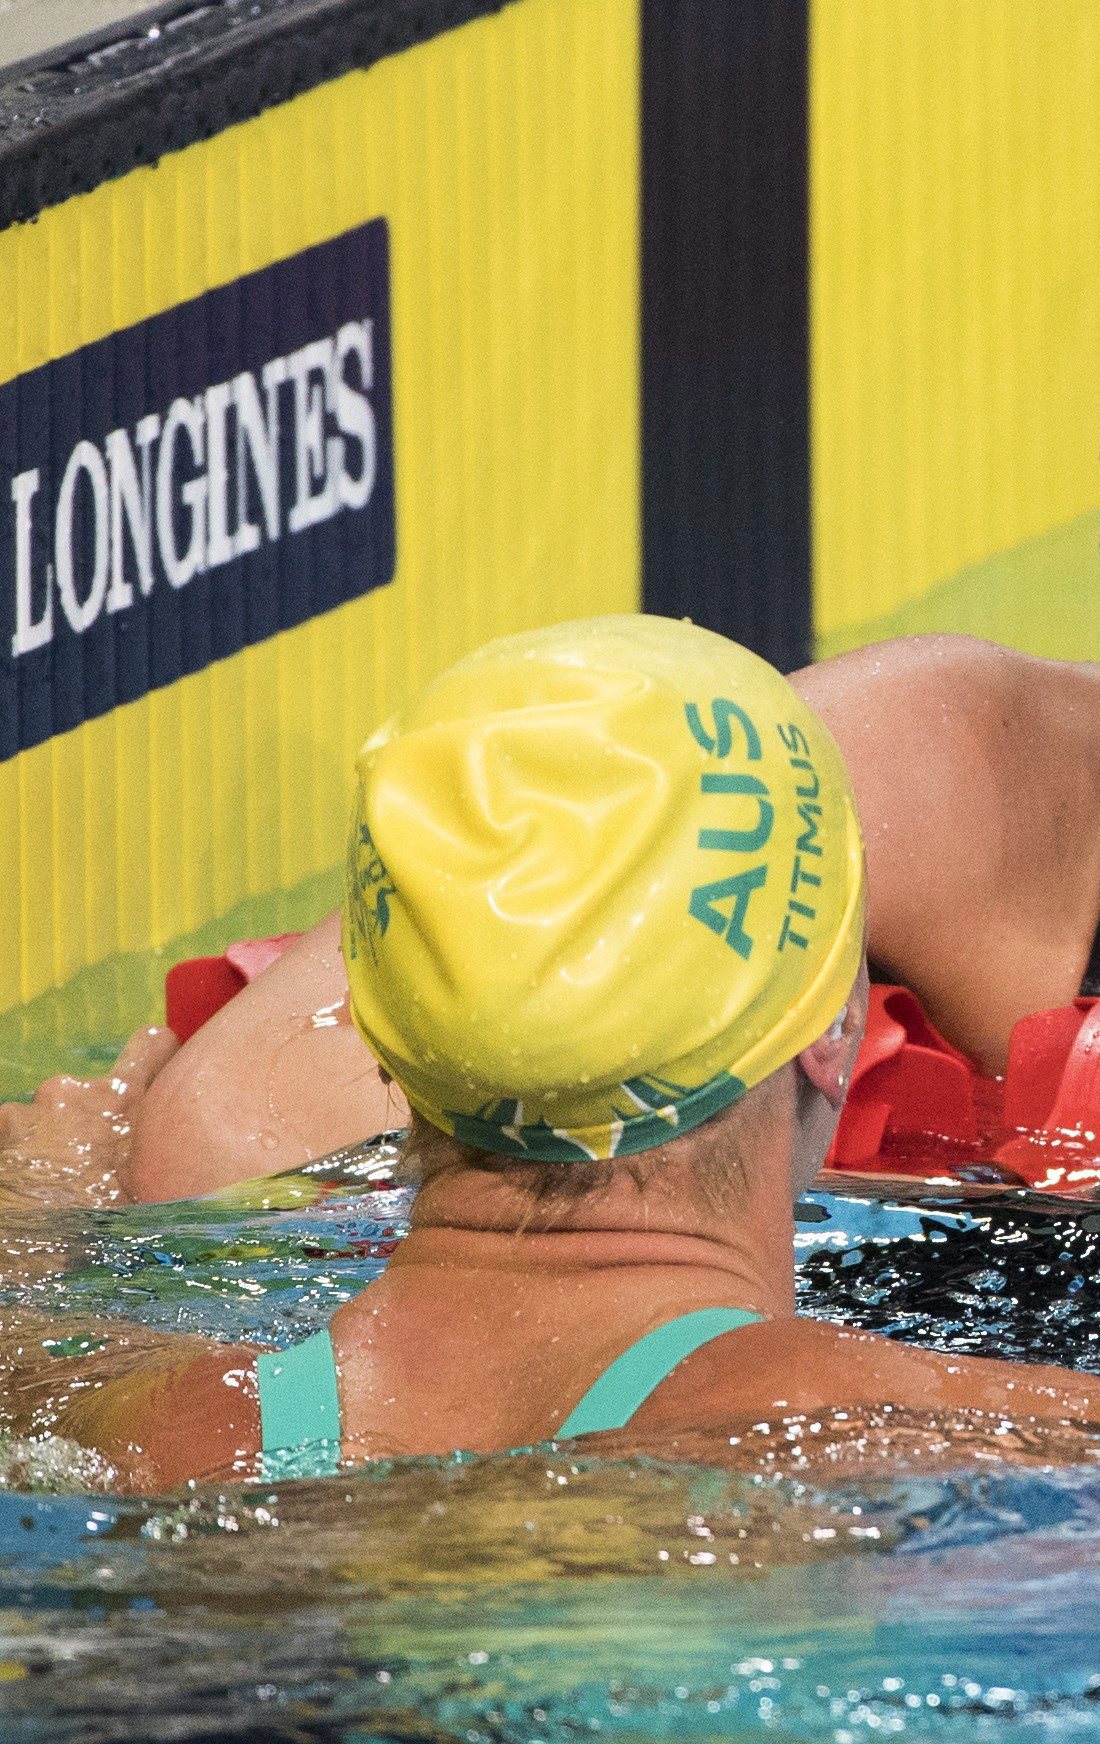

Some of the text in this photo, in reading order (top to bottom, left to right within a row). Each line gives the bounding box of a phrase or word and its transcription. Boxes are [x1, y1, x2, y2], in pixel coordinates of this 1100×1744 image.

[11, 318, 376, 657] LONGINES
[684, 697, 775, 960] AUS
[776, 723, 824, 952] TITMUS
